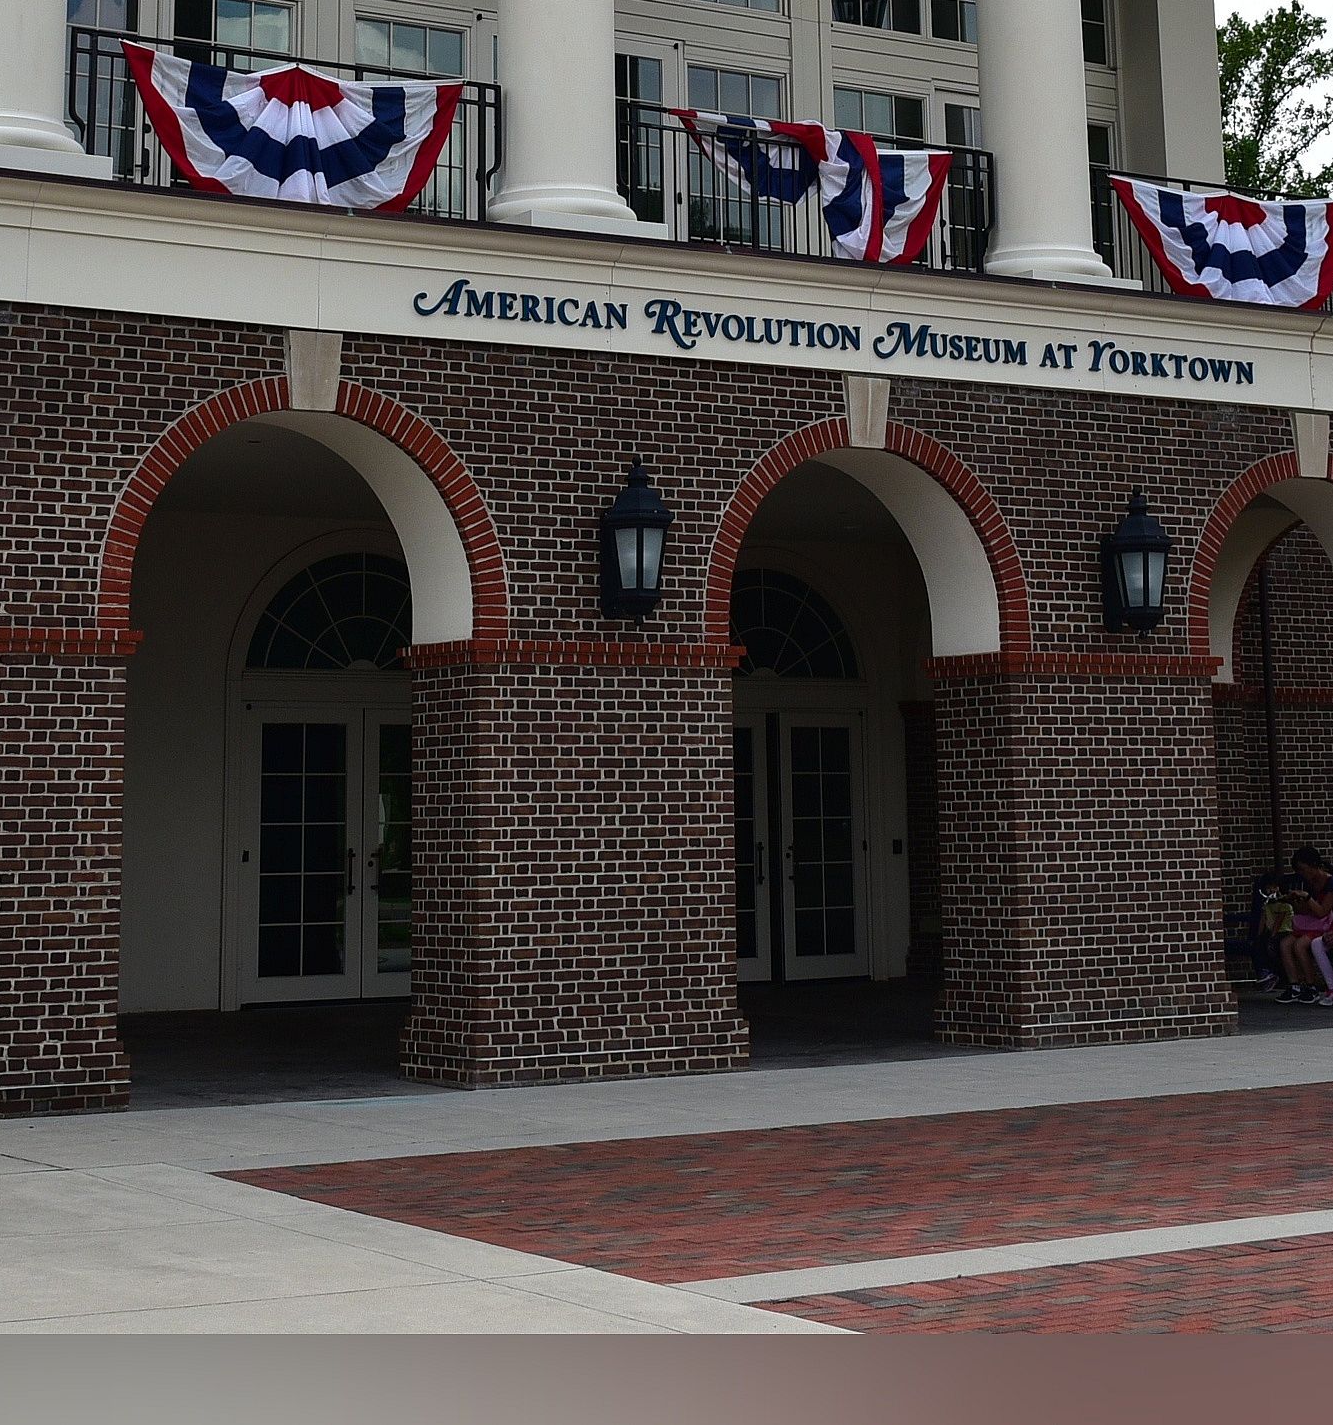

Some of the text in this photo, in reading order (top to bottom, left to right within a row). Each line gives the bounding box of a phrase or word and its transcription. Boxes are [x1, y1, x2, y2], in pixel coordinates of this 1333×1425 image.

[412, 278, 1256, 385] AMERICAN REVOLUTION MUSEUM AT YORKTOWN
